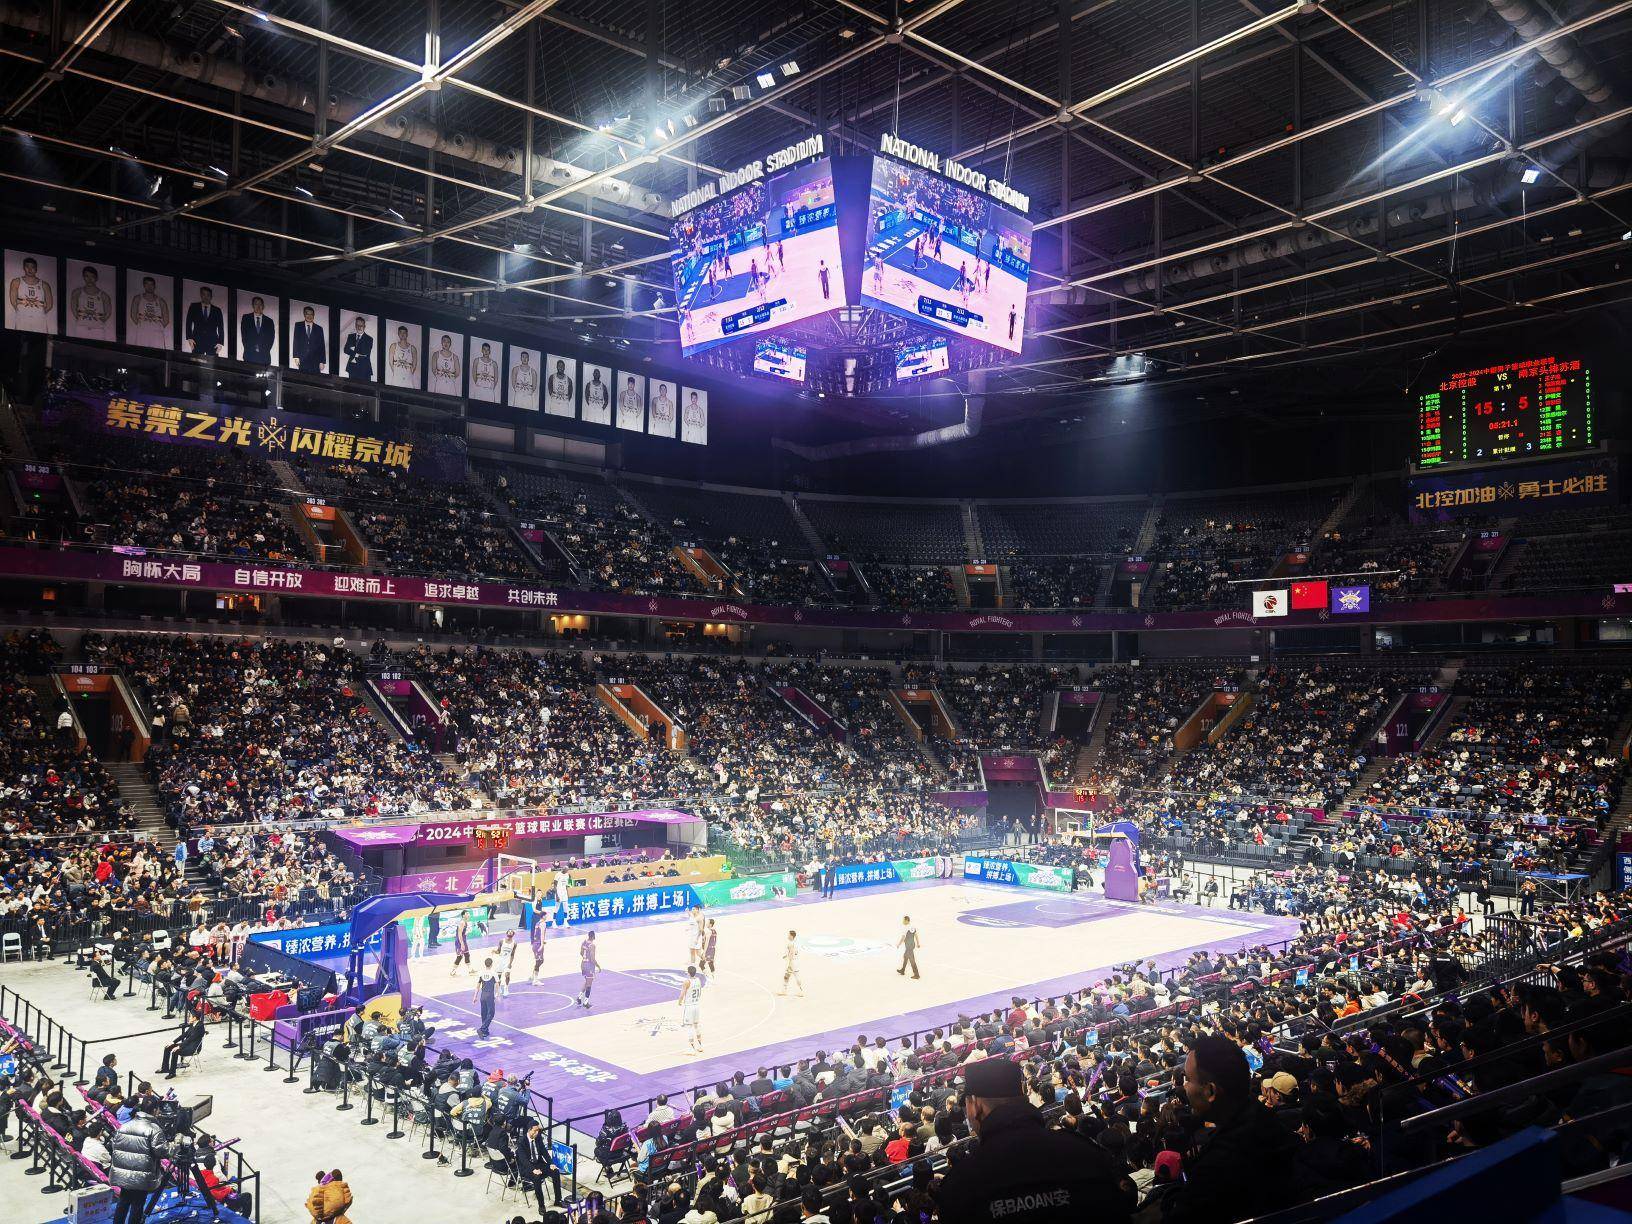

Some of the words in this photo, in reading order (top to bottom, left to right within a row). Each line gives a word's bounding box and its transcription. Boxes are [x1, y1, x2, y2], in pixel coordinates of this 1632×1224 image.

[880, 133, 941, 173] NATIONAL
[945, 158, 986, 192] INDOOR
[671, 182, 718, 218] NATIONAL
[719, 161, 764, 194] INDOOR
[767, 134, 824, 173] STADIUM
[1497, 372, 1508, 382] VS
[1439, 378, 1477, 392] 北京控股
[1474, 401, 1494, 416] 15
[1518, 396, 1529, 410] 5
[105, 398, 253, 446] 紫禁之光
[1488, 419, 1519, 430] 05:21.1
[291, 426, 414, 472] 闪耀京城
[1476, 448, 1483, 457] 2
[1526, 442, 1532, 450] 3
[1518, 474, 1608, 499] 勇士必胜
[1416, 487, 1496, 509] 北控加油
[122, 559, 201, 582] 胸怀大局
[234, 568, 303, 590] 自信开放
[334, 575, 396, 596] 迎难而上
[424, 582, 480, 601] 追求卓越
[507, 589, 558, 606] 共创未来
[710, 605, 726, 616] ROYAL
[726, 604, 748, 620] FIGHTERS
[1214, 613, 1232, 626] ROYAL
[969, 616, 986, 628] ROYAL
[987, 615, 1014, 628] FIGHTERS
[70, 665, 83, 674] 104
[86, 665, 98, 674] 103
[381, 672, 391, 680] 103
[392, 672, 402, 680] 102
[1396, 723, 1409, 737] 121
[691, 989, 700, 999] 21
[989, 1188, 1071, 1218] 保BAOAN安
